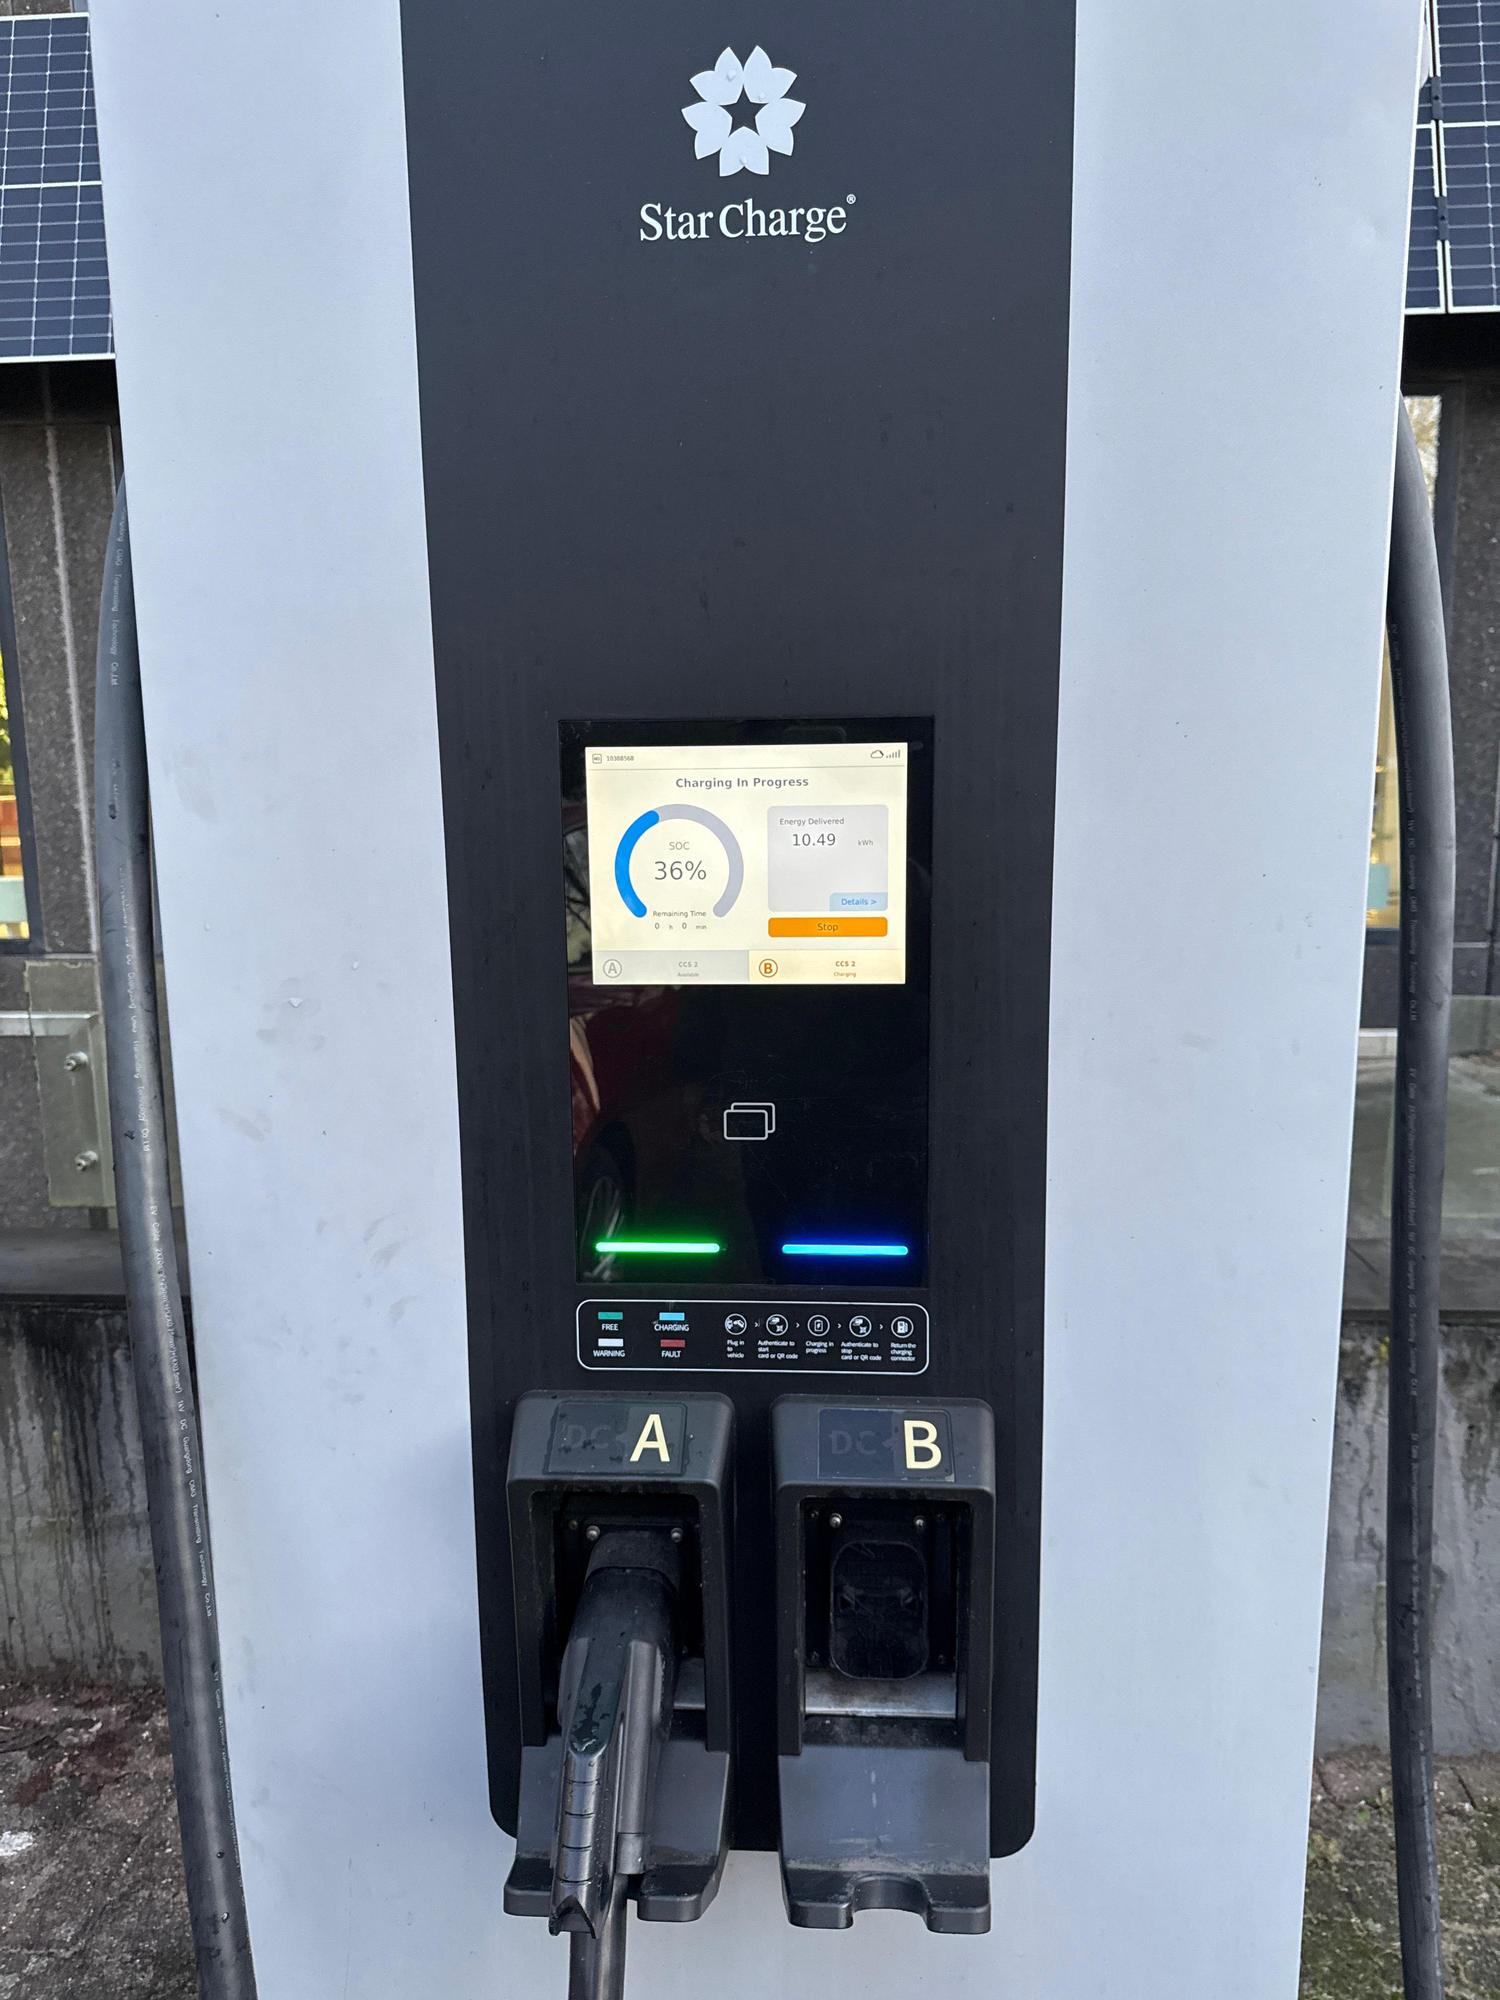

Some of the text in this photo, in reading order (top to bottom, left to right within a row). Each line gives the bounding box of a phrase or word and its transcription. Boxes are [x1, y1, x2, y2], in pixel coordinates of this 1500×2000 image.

[640, 202, 713, 241] Star
[675, 777, 809, 790] Charging In Progress
[779, 817, 845, 827] Energy Delivered
[792, 833, 836, 847] 10.49
[668, 841, 690, 851] SOC
[654, 860, 707, 881] 36%
[841, 898, 868, 906] Details
[652, 910, 689, 918] Remaining
[654, 922, 660, 930] 0
[681, 922, 687, 930] 0
[817, 923, 839, 933] Stop
[607, 963, 618, 974] A
[763, 962, 773, 974] B
[601, 1323, 619, 1331] FREE
[654, 1323, 690, 1332] CHARGING
[805, 1340, 828, 1348] Charging
[661, 1350, 682, 1358] FAULT
[629, 1413, 671, 1462] A
[830, 1429, 877, 1455] DC
[903, 1419, 942, 1470] B
